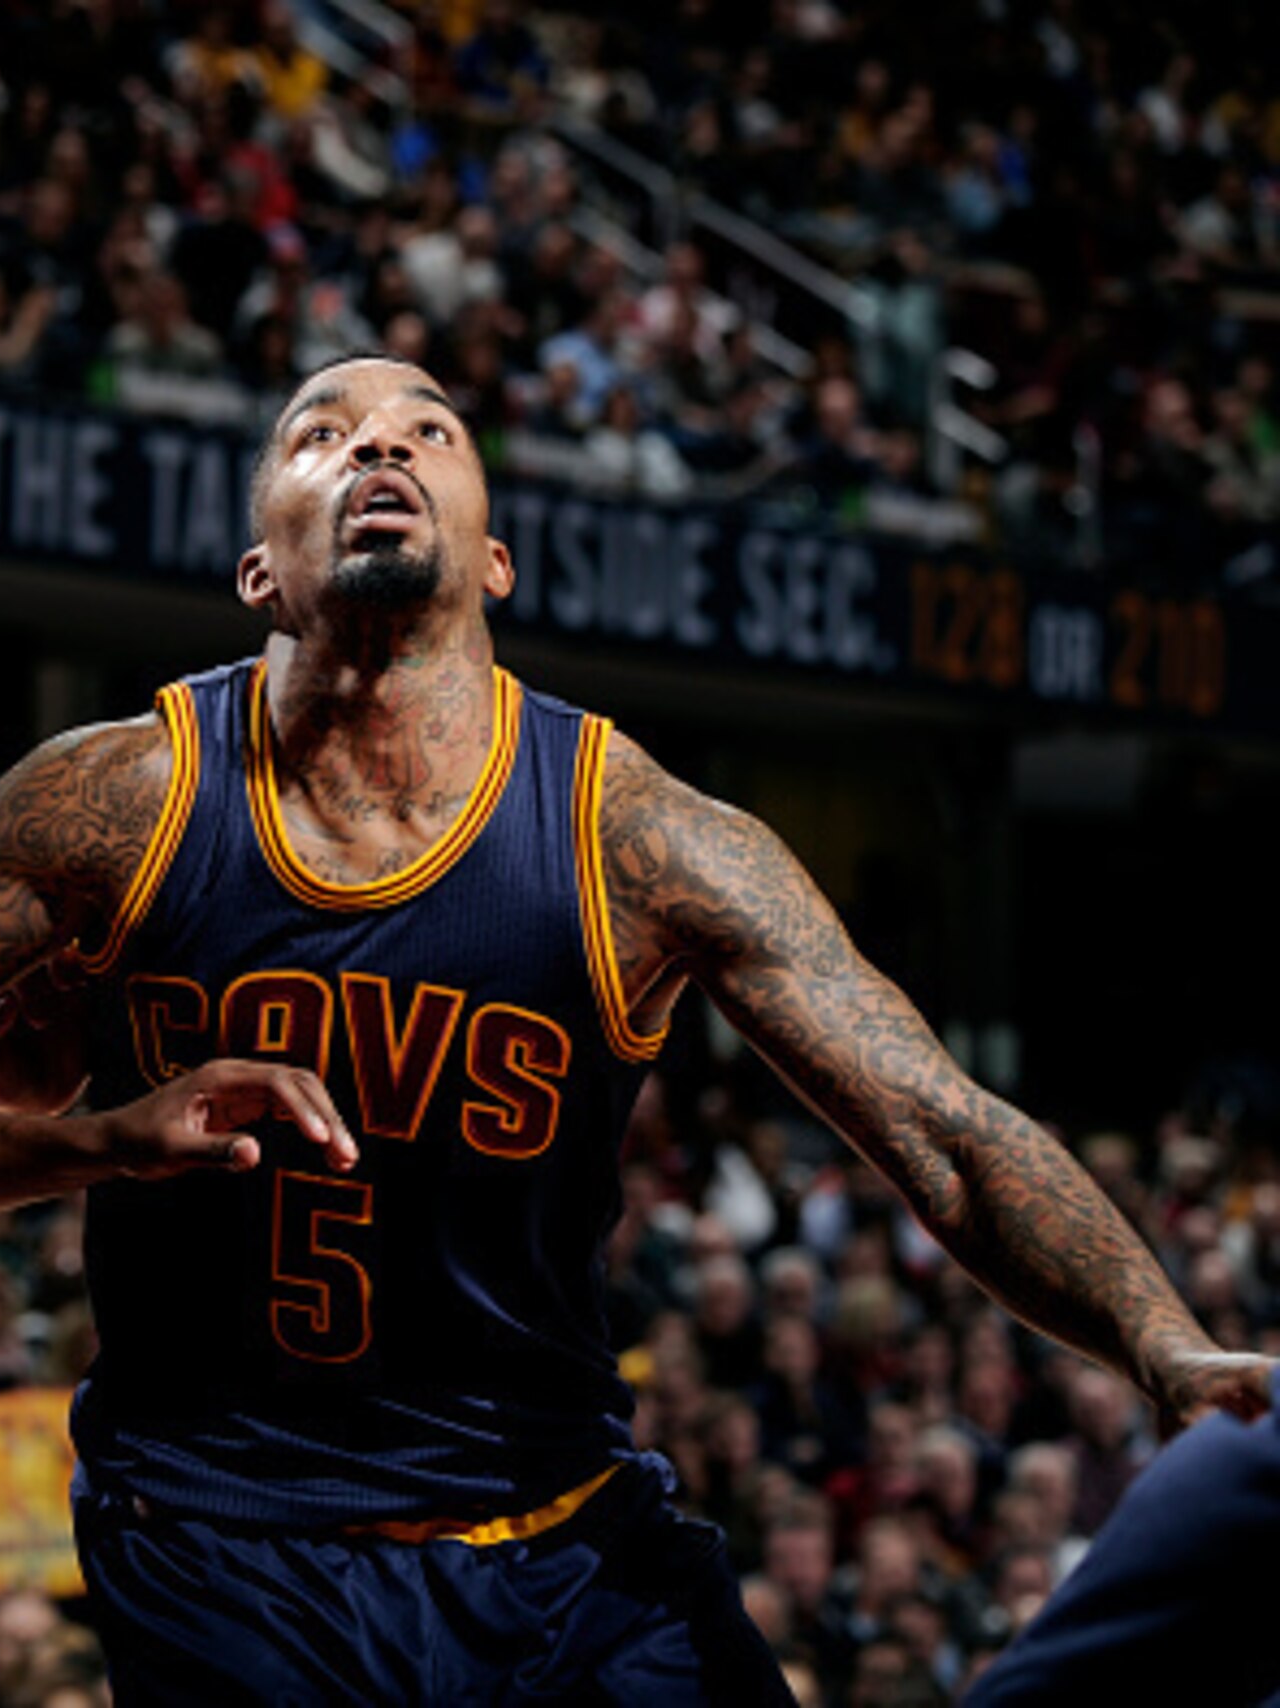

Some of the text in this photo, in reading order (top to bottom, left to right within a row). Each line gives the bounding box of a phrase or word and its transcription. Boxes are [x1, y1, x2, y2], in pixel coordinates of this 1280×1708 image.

[144, 433, 257, 573] TA
[492, 492, 719, 649] TSIDE
[1028, 602, 1104, 703] OR
[1110, 588, 1228, 717] 210
[127, 969, 572, 1160] CAVS
[271, 1168, 373, 1363] 5
